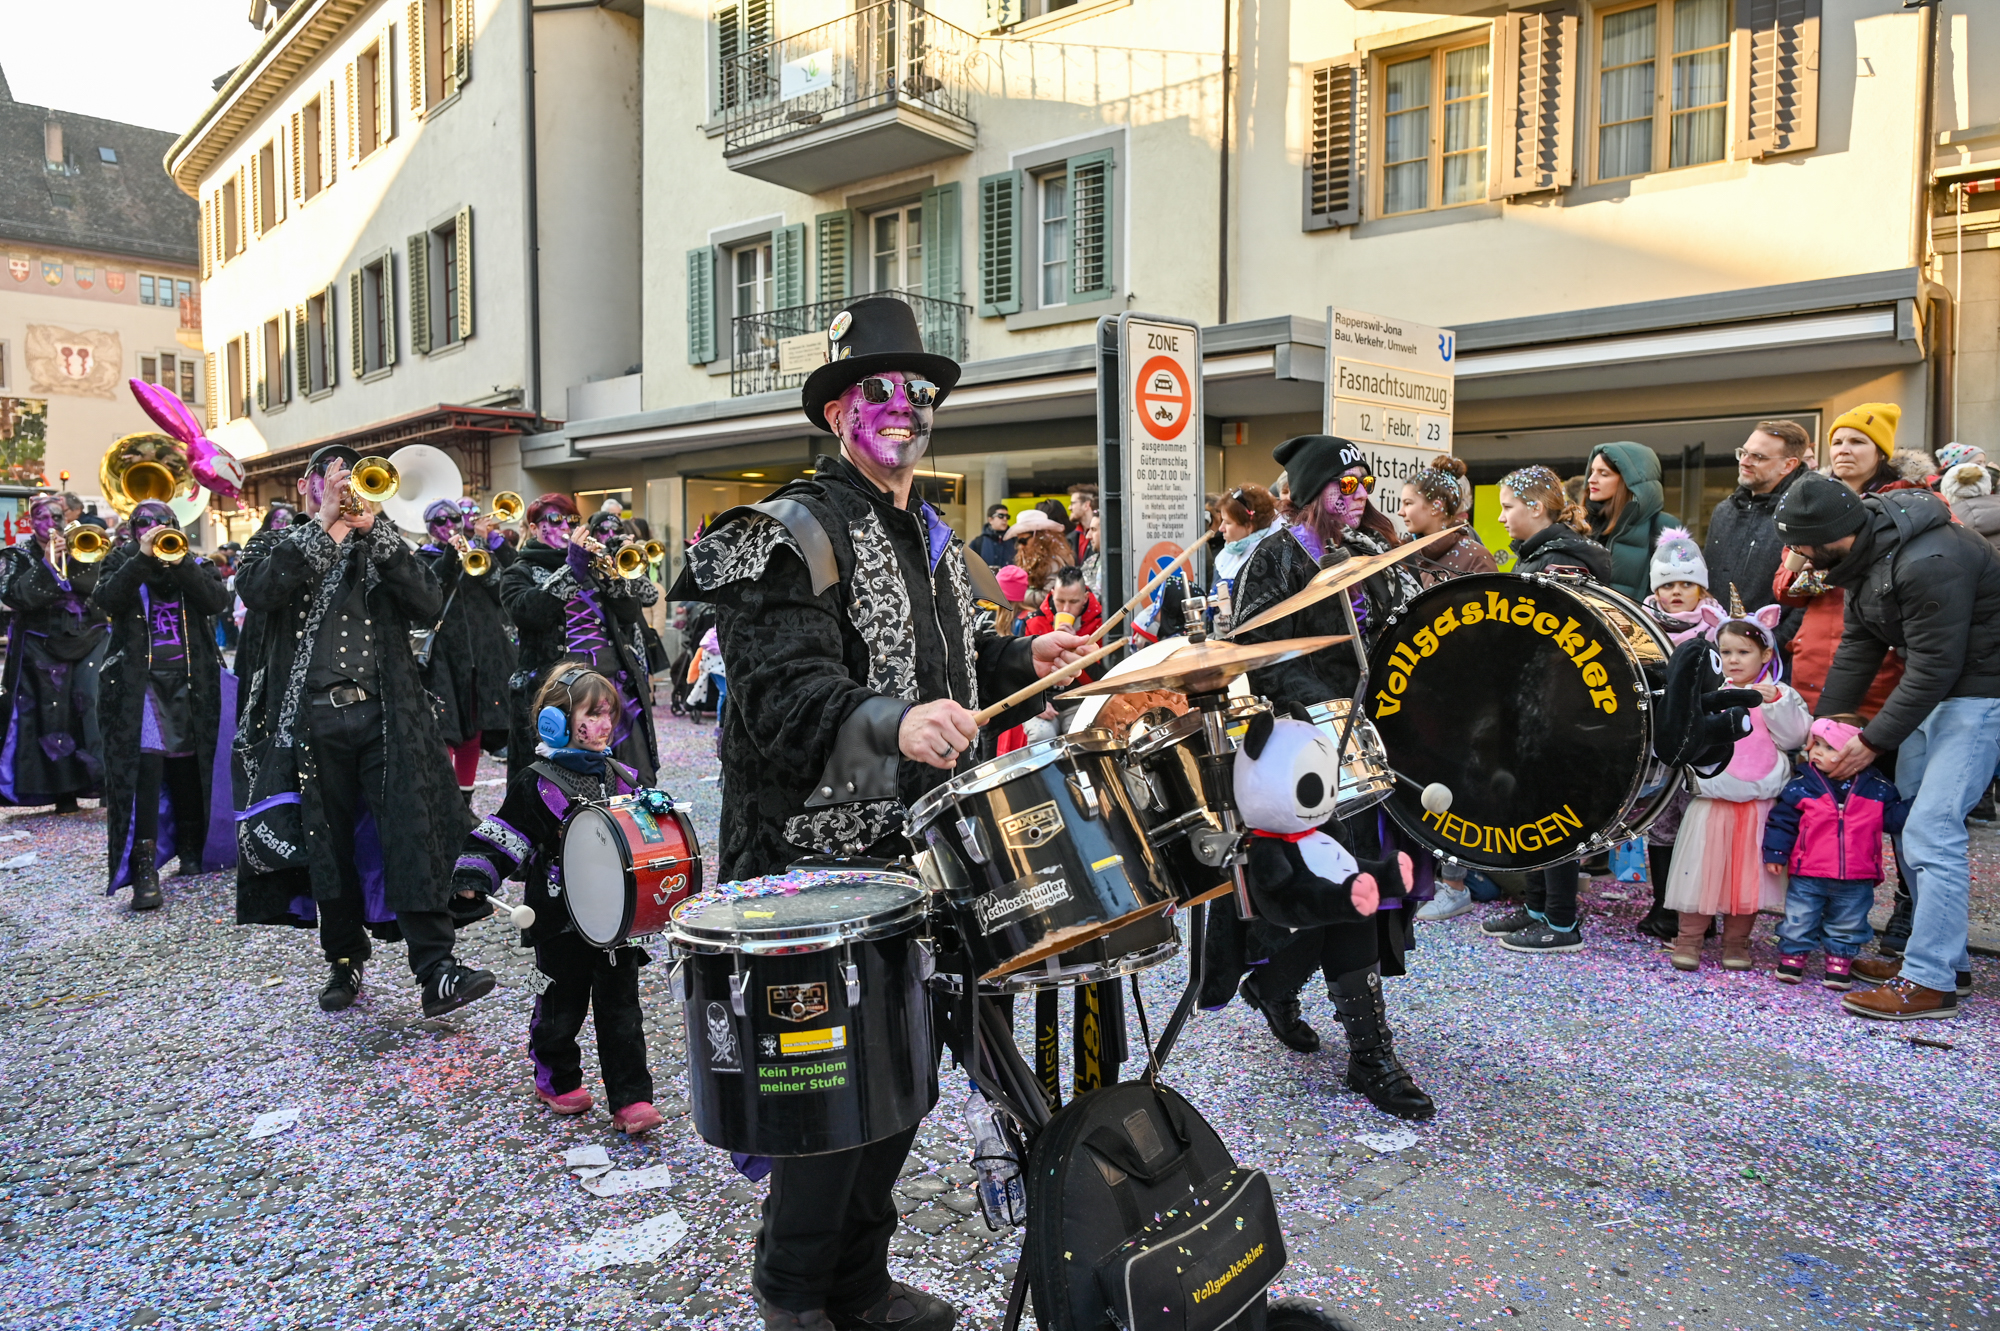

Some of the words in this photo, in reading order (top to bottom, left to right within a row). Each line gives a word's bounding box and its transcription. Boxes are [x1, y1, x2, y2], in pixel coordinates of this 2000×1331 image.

[1335, 313, 1402, 336] Rapperswil-Jona
[1148, 333, 1178, 352] ZONE
[1334, 329, 1353, 344] Bau,
[1354, 332, 1386, 350] Verkehr,
[1388, 341, 1418, 355] Umwelt
[1339, 366, 1448, 410] Fasnachtsumzug
[1360, 413, 1374, 432] 12.
[1388, 417, 1414, 438] Febr.
[1427, 423, 1440, 441] 23
[1141, 442, 1187, 454] ausgenommen
[1140, 454, 1188, 469] Güterumschlag
[1362, 451, 1426, 480] ltstadt
[1136, 468, 1178, 480] 06.00-21.00
[1180, 470, 1191, 481] Uhr
[1141, 493, 1188, 502] Uebernachtungsgäste
[1147, 483, 1163, 491] Zufahrt
[1142, 512, 1166, 521] Bewilligung
[1168, 513, 1188, 521] gestattet
[1375, 590, 1618, 720] Vollgashöckler
[1422, 804, 1584, 854] HEDINGEN
[252, 820, 296, 860] Rösti
[988, 878, 1065, 920] schlosshüüler
[1034, 890, 1066, 910] bürglen
[758, 1066, 787, 1078] Kein
[792, 1060, 846, 1076] Problem
[760, 1080, 806, 1093] meiner
[810, 1075, 846, 1090] Stufe
[1192, 1242, 1264, 1304] Vollgashöckler
